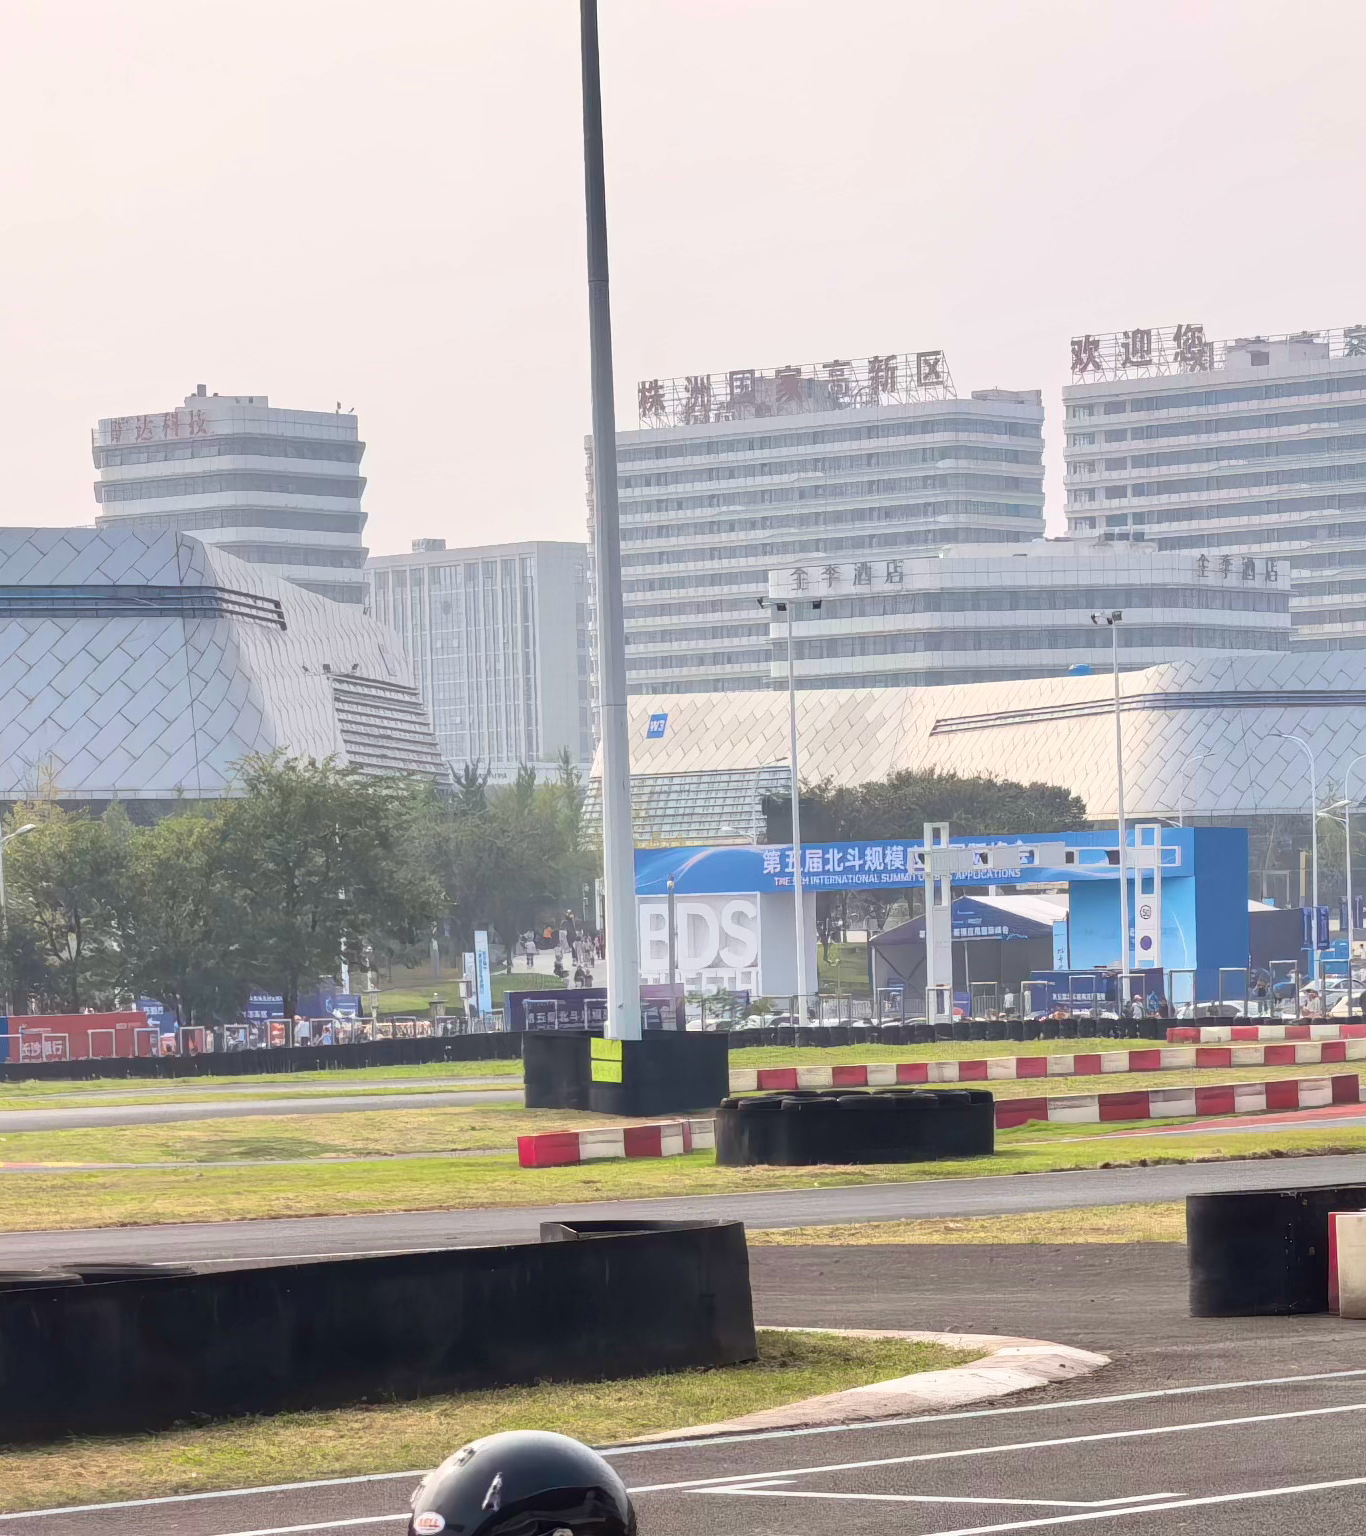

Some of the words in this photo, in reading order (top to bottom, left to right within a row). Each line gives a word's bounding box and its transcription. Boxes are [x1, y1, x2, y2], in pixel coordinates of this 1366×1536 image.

[638, 350, 943, 417] 株洲国家高新区
[790, 559, 905, 591] 全季酒店
[810, 873, 879, 885] INTERNATIONAL
[881, 872, 917, 883] SUMMIT
[956, 868, 1021, 881] APPLICATIONS
[639, 899, 757, 969] BDS
